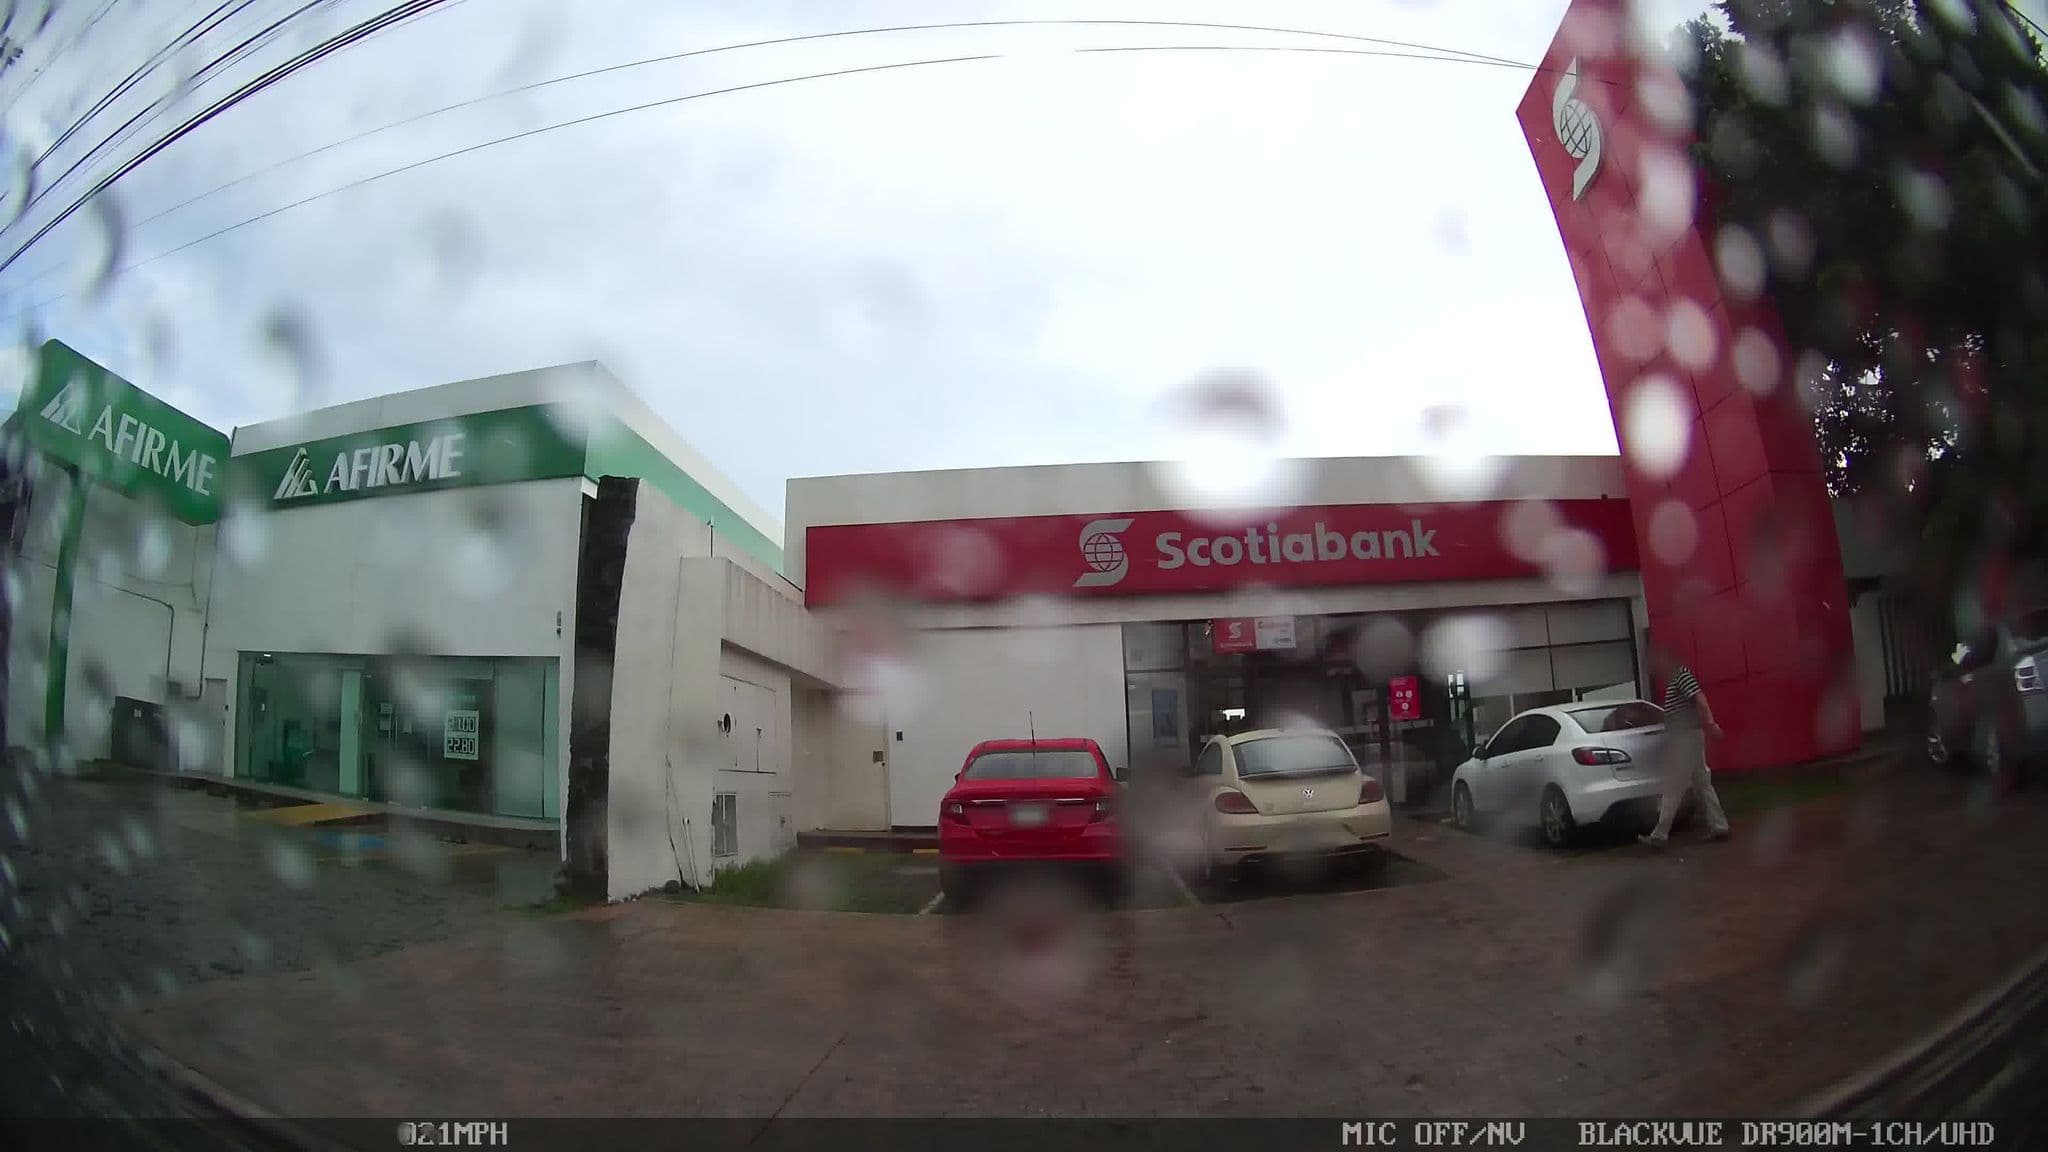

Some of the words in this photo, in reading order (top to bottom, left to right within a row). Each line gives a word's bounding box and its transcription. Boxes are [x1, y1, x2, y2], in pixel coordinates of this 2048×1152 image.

[87, 404, 216, 497] AFIRME
[323, 433, 466, 494] AFIRME
[1155, 519, 1441, 570] Scotiabank
